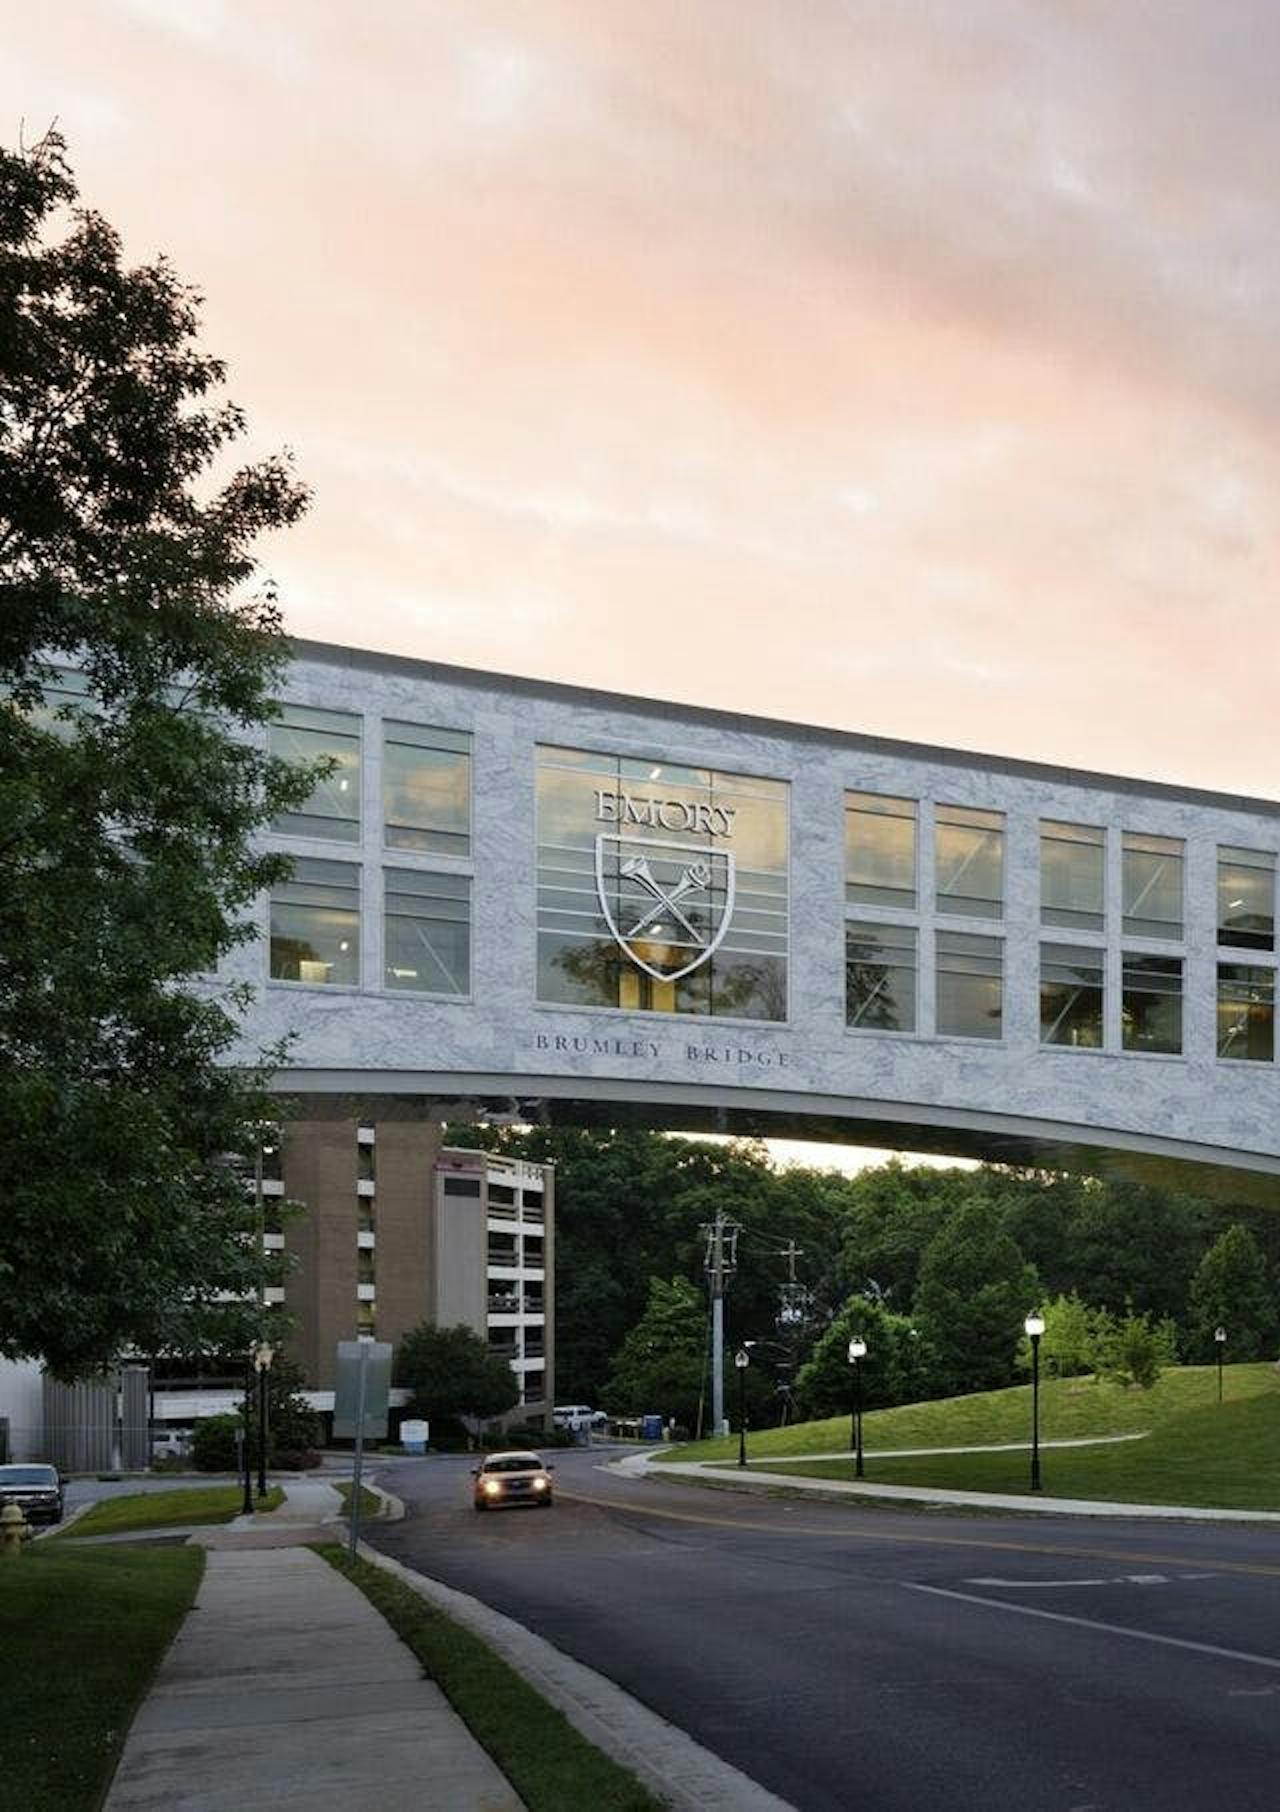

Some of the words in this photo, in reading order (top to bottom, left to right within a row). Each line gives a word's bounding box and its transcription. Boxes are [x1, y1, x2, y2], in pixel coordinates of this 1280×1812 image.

[594, 790, 736, 838] EMORY
[537, 1034, 662, 1057] BRUMLEY
[687, 1045, 790, 1067] BRIDGE
